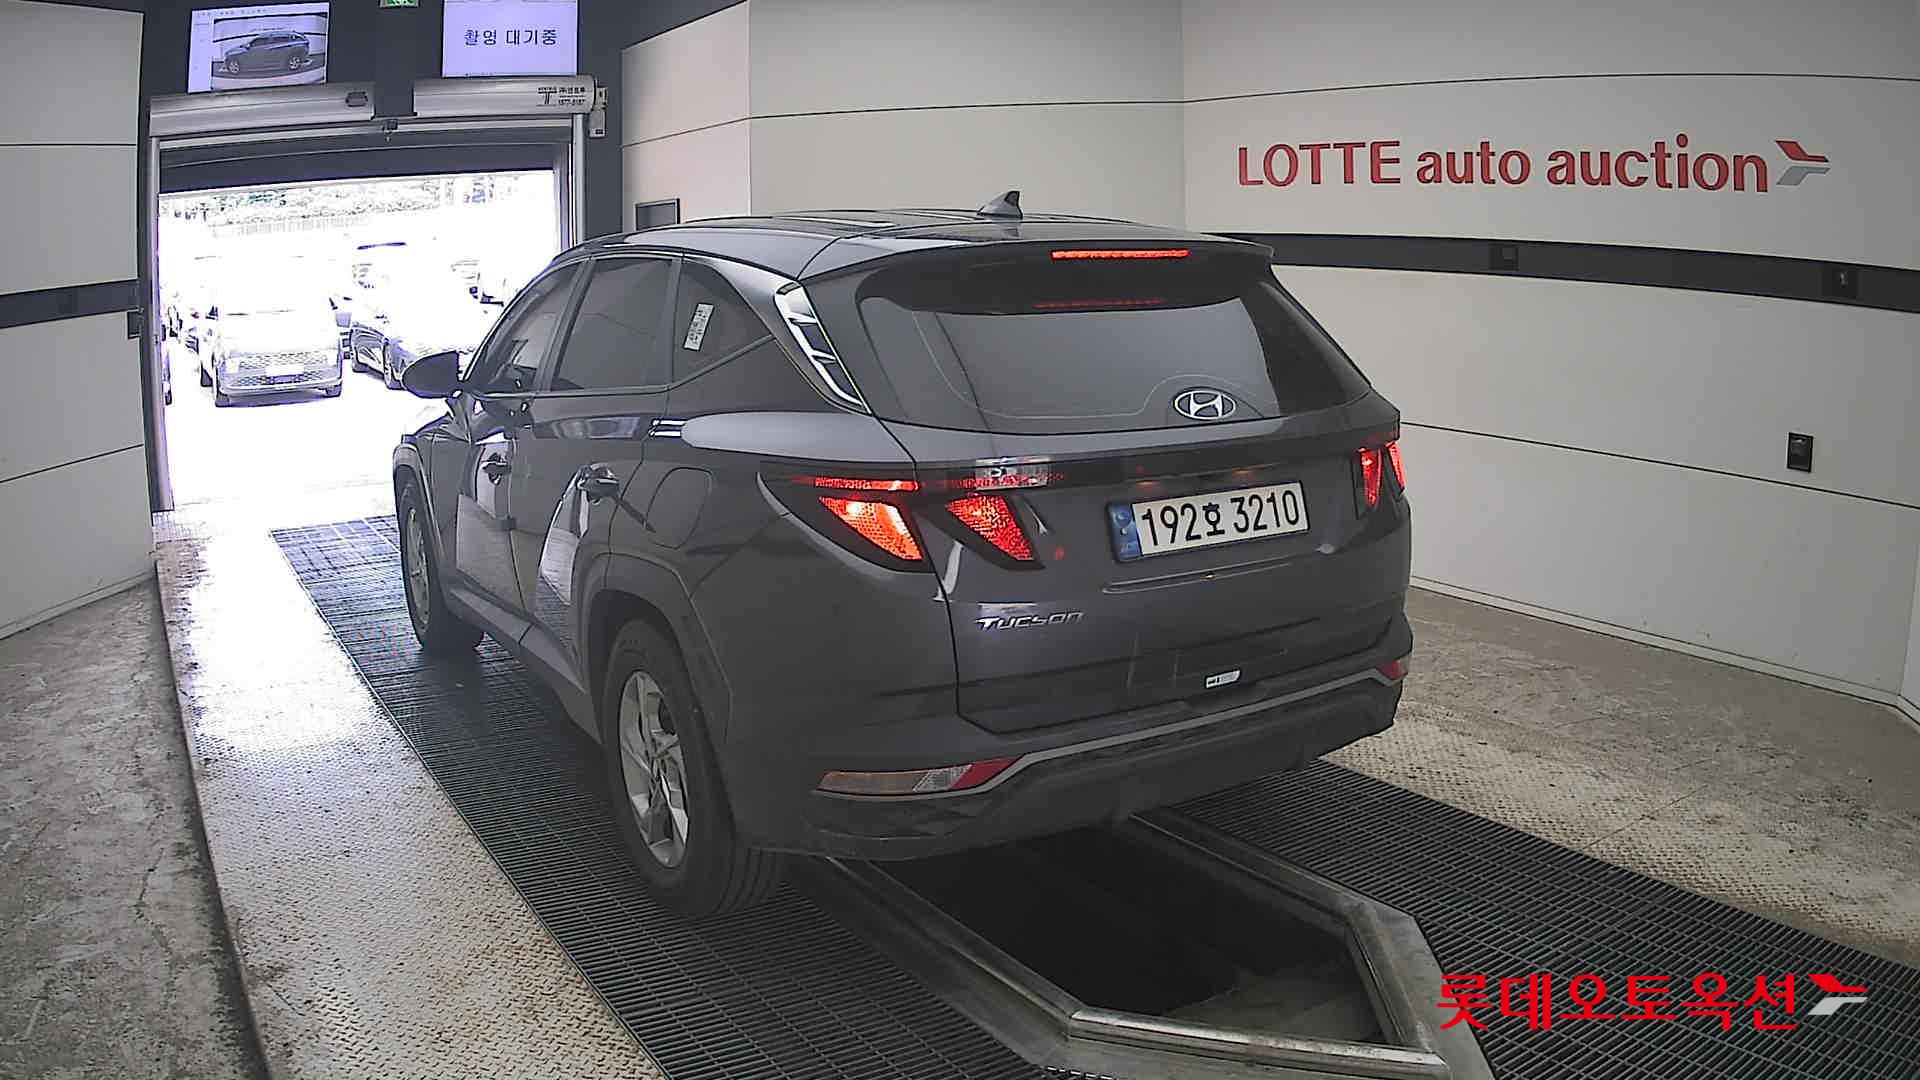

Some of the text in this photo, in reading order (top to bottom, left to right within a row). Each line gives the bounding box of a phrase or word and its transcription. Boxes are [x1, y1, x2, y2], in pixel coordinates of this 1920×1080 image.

[506, 29, 557, 46] 대기중
[1238, 133, 1768, 192] LOTTE auto auction
[976, 610, 1084, 631] TUCSON
